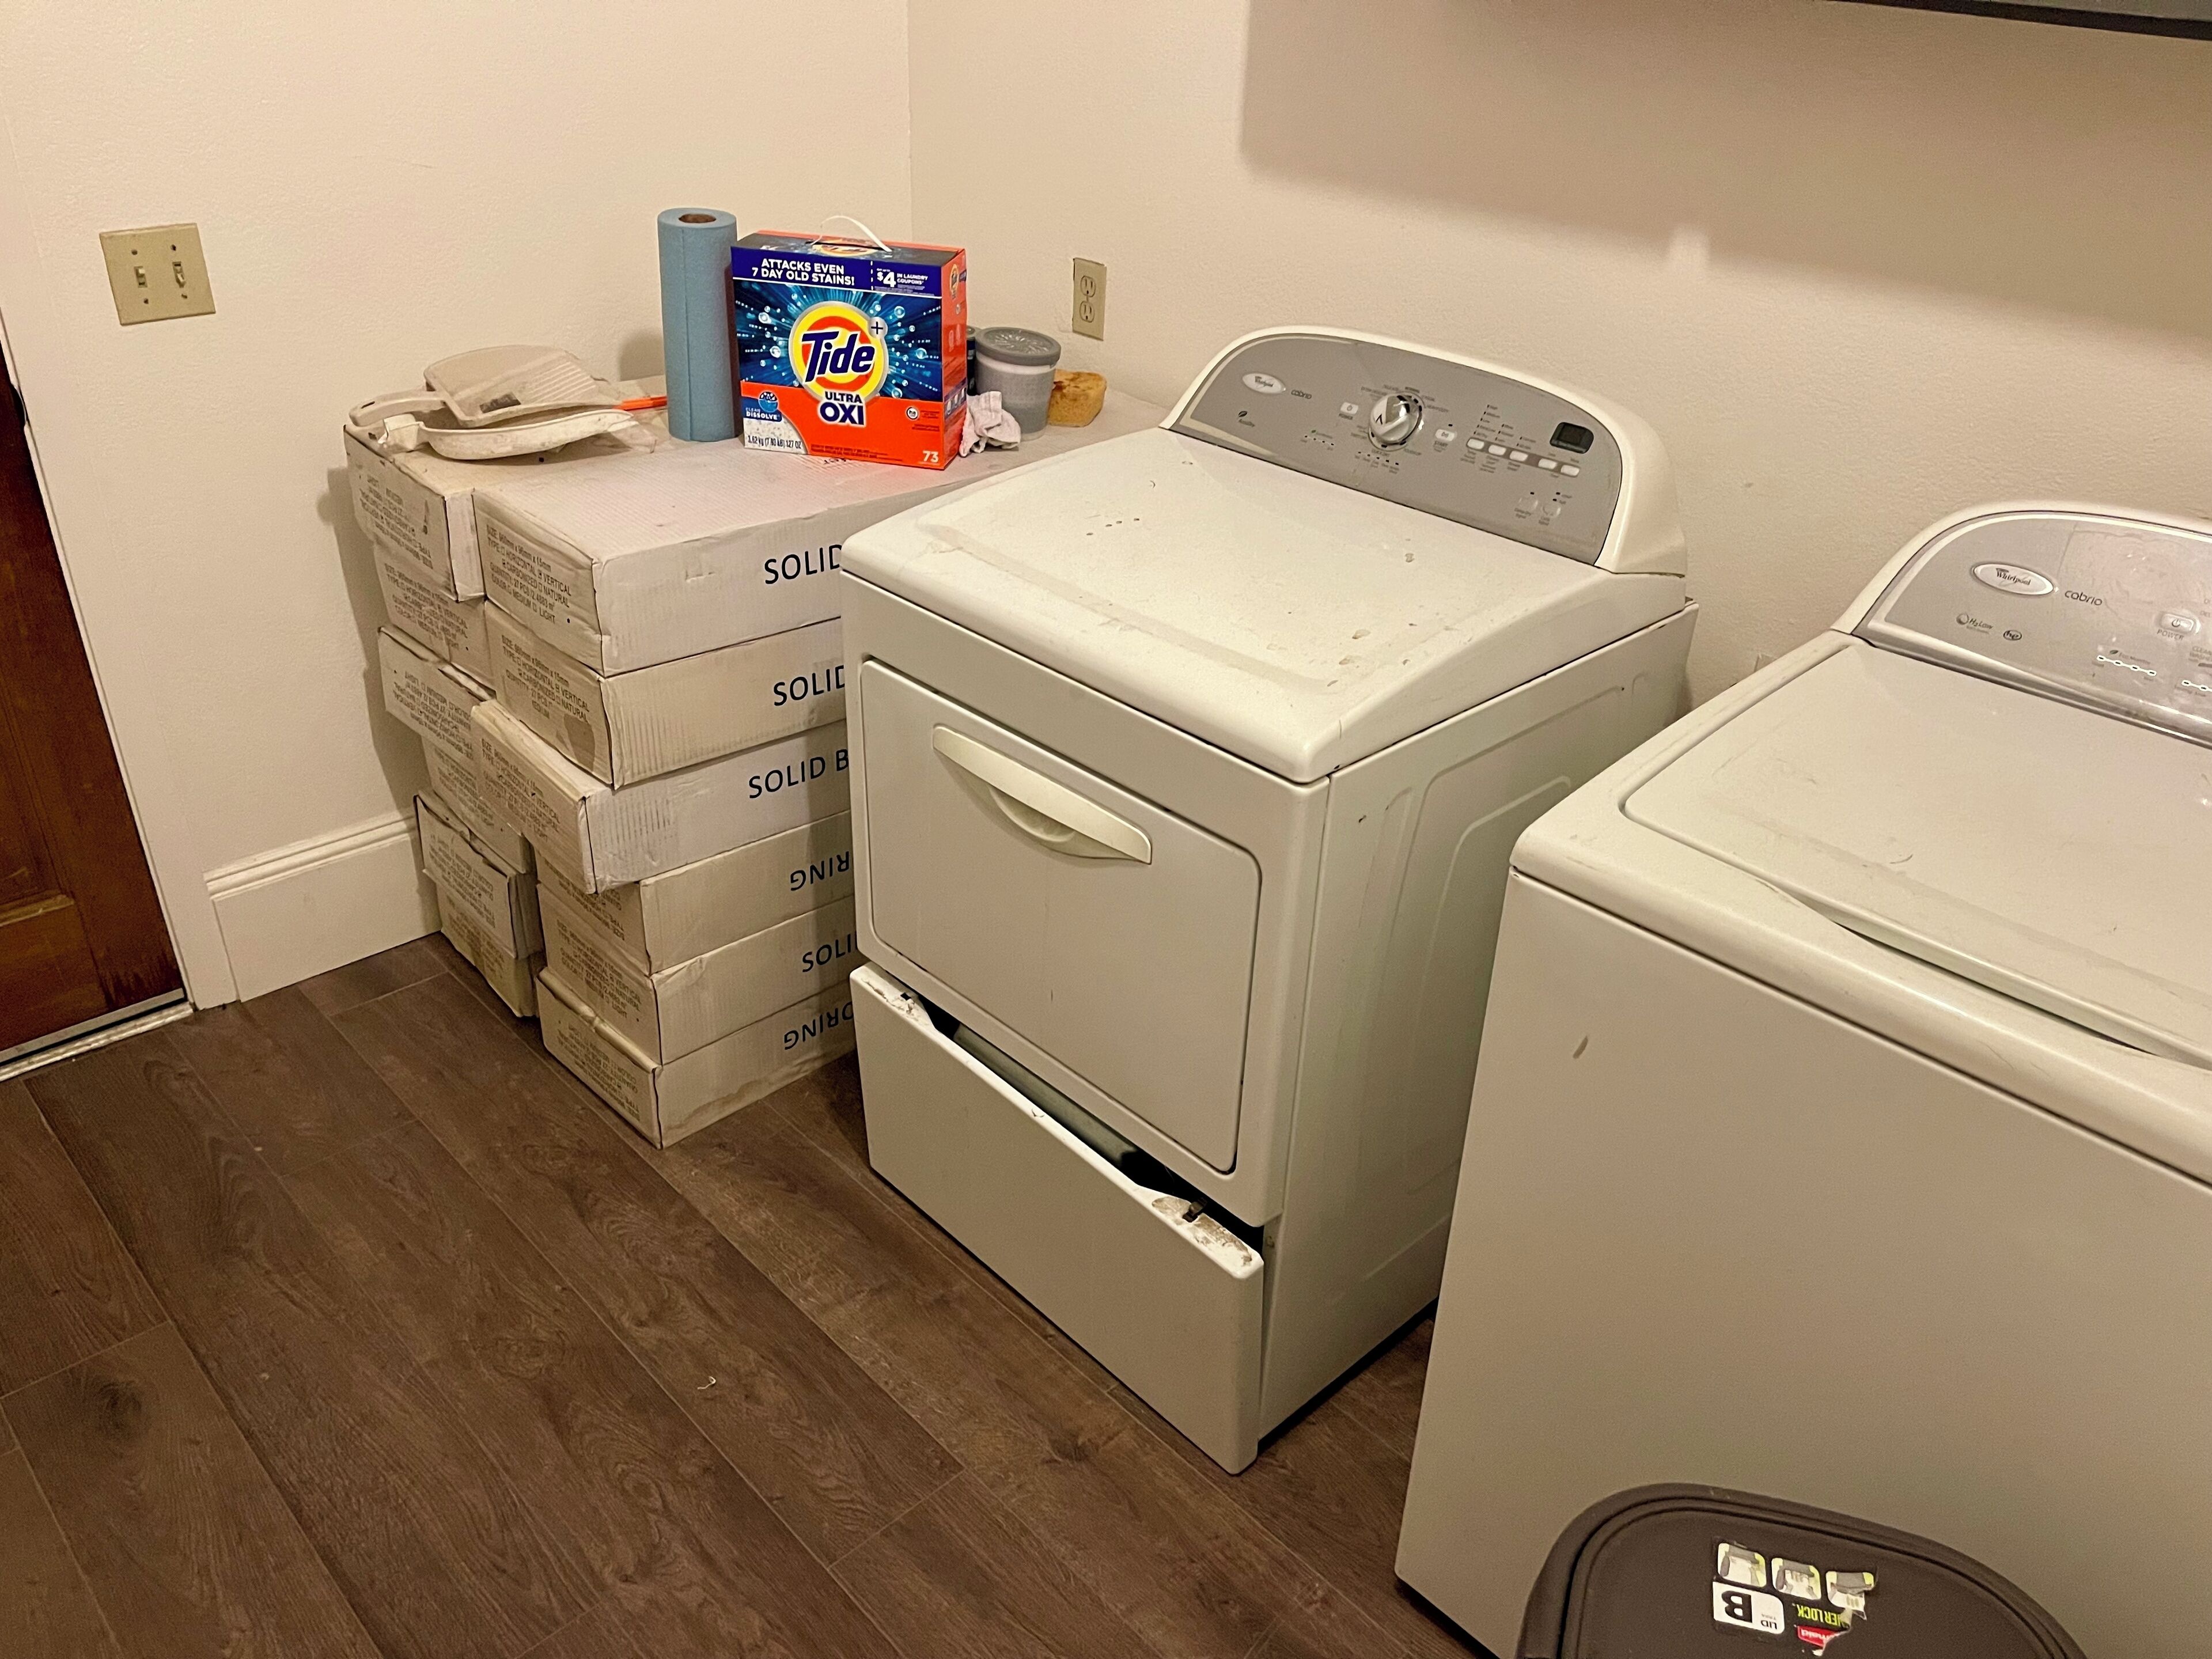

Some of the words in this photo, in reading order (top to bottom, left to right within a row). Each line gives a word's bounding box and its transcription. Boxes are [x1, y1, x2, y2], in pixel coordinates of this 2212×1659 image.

[762, 259, 811, 271] ATTACKS
[814, 263, 844, 274] EVEN
[752, 267, 758, 276] 7
[762, 268, 783, 278] DAY
[786, 271, 809, 281] OLD
[812, 273, 855, 286] STAINS!
[877, 271, 896, 287] $4
[802, 331, 875, 382] Tide
[825, 391, 862, 404] ULTRA
[746, 411, 778, 420] DISSOLVE
[820, 403, 864, 425] OXI
[923, 450, 938, 463] 73
[536, 556, 551, 571] 15mm
[764, 544, 842, 584] SOLID
[543, 571, 571, 597] VERTICAL
[1996, 569, 2031, 585] Whirlpool
[513, 578, 519, 589] 27
[519, 582, 529, 596] PCS
[543, 584, 569, 609] NATURAL
[2065, 590, 2103, 605] cabrio
[539, 605, 555, 625] LIGHT
[2006, 630, 2019, 639] he
[2157, 629, 2185, 641] POWER
[560, 685, 589, 713] VERTICAL
[561, 697, 588, 724] NATURAL
[749, 757, 825, 798] SOLID
[790, 851, 849, 891] RING
[802, 931, 857, 972] SOLI
[1722, 1591, 1752, 1623] B
[1796, 1604, 1824, 1623] LOCK
[1761, 1620, 1778, 1630] LID
